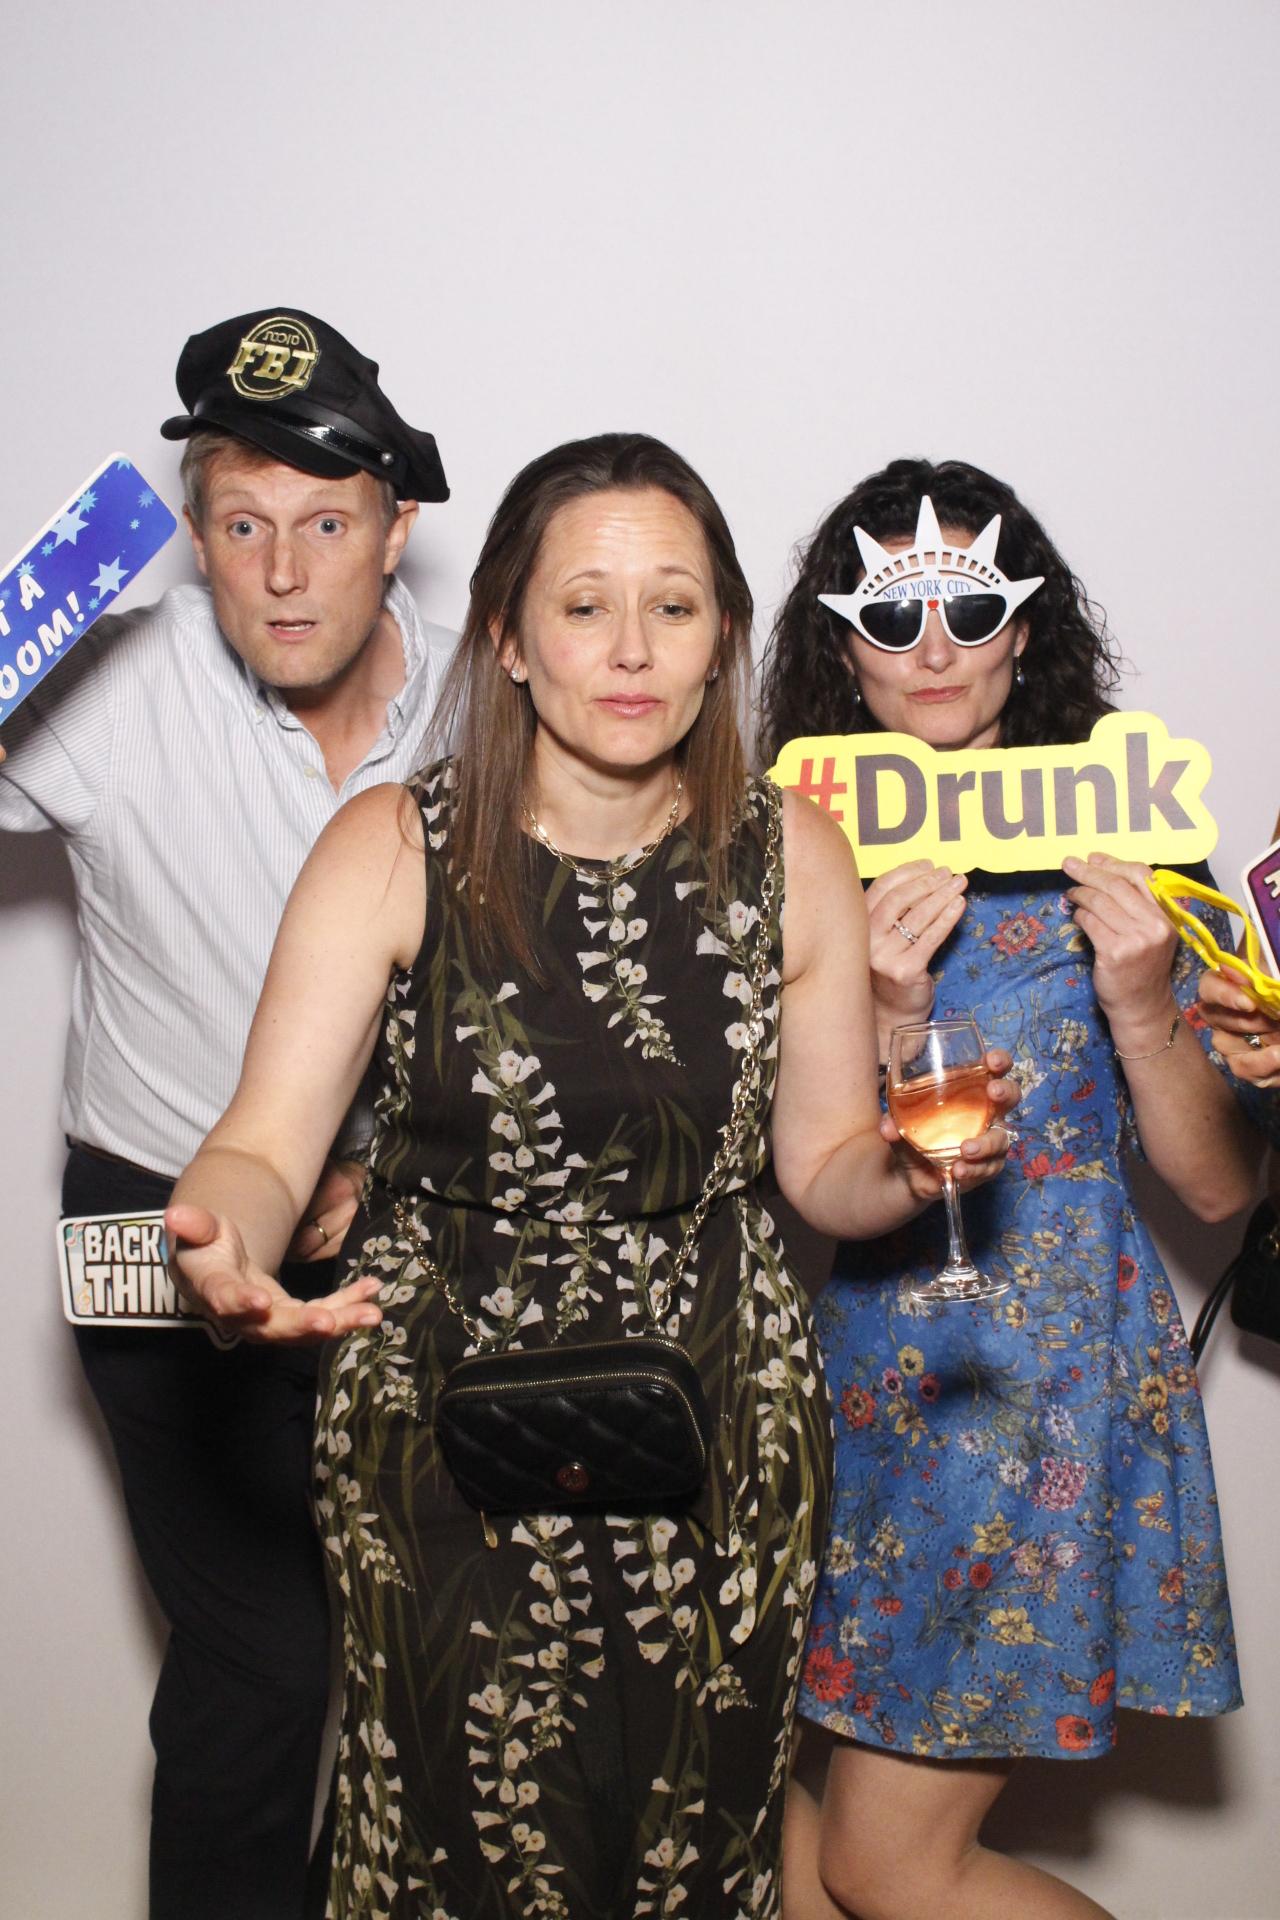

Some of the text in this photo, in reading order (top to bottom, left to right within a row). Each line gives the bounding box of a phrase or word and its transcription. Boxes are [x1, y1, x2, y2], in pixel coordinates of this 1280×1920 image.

[226, 338, 317, 386] FBI
[883, 580, 971, 600] NEW YORK CITY
[0, 591, 85, 715] OOM!
[784, 732, 1198, 846] #Drunk
[84, 1224, 161, 1263] BACK
[84, 1265, 188, 1315] THIN
